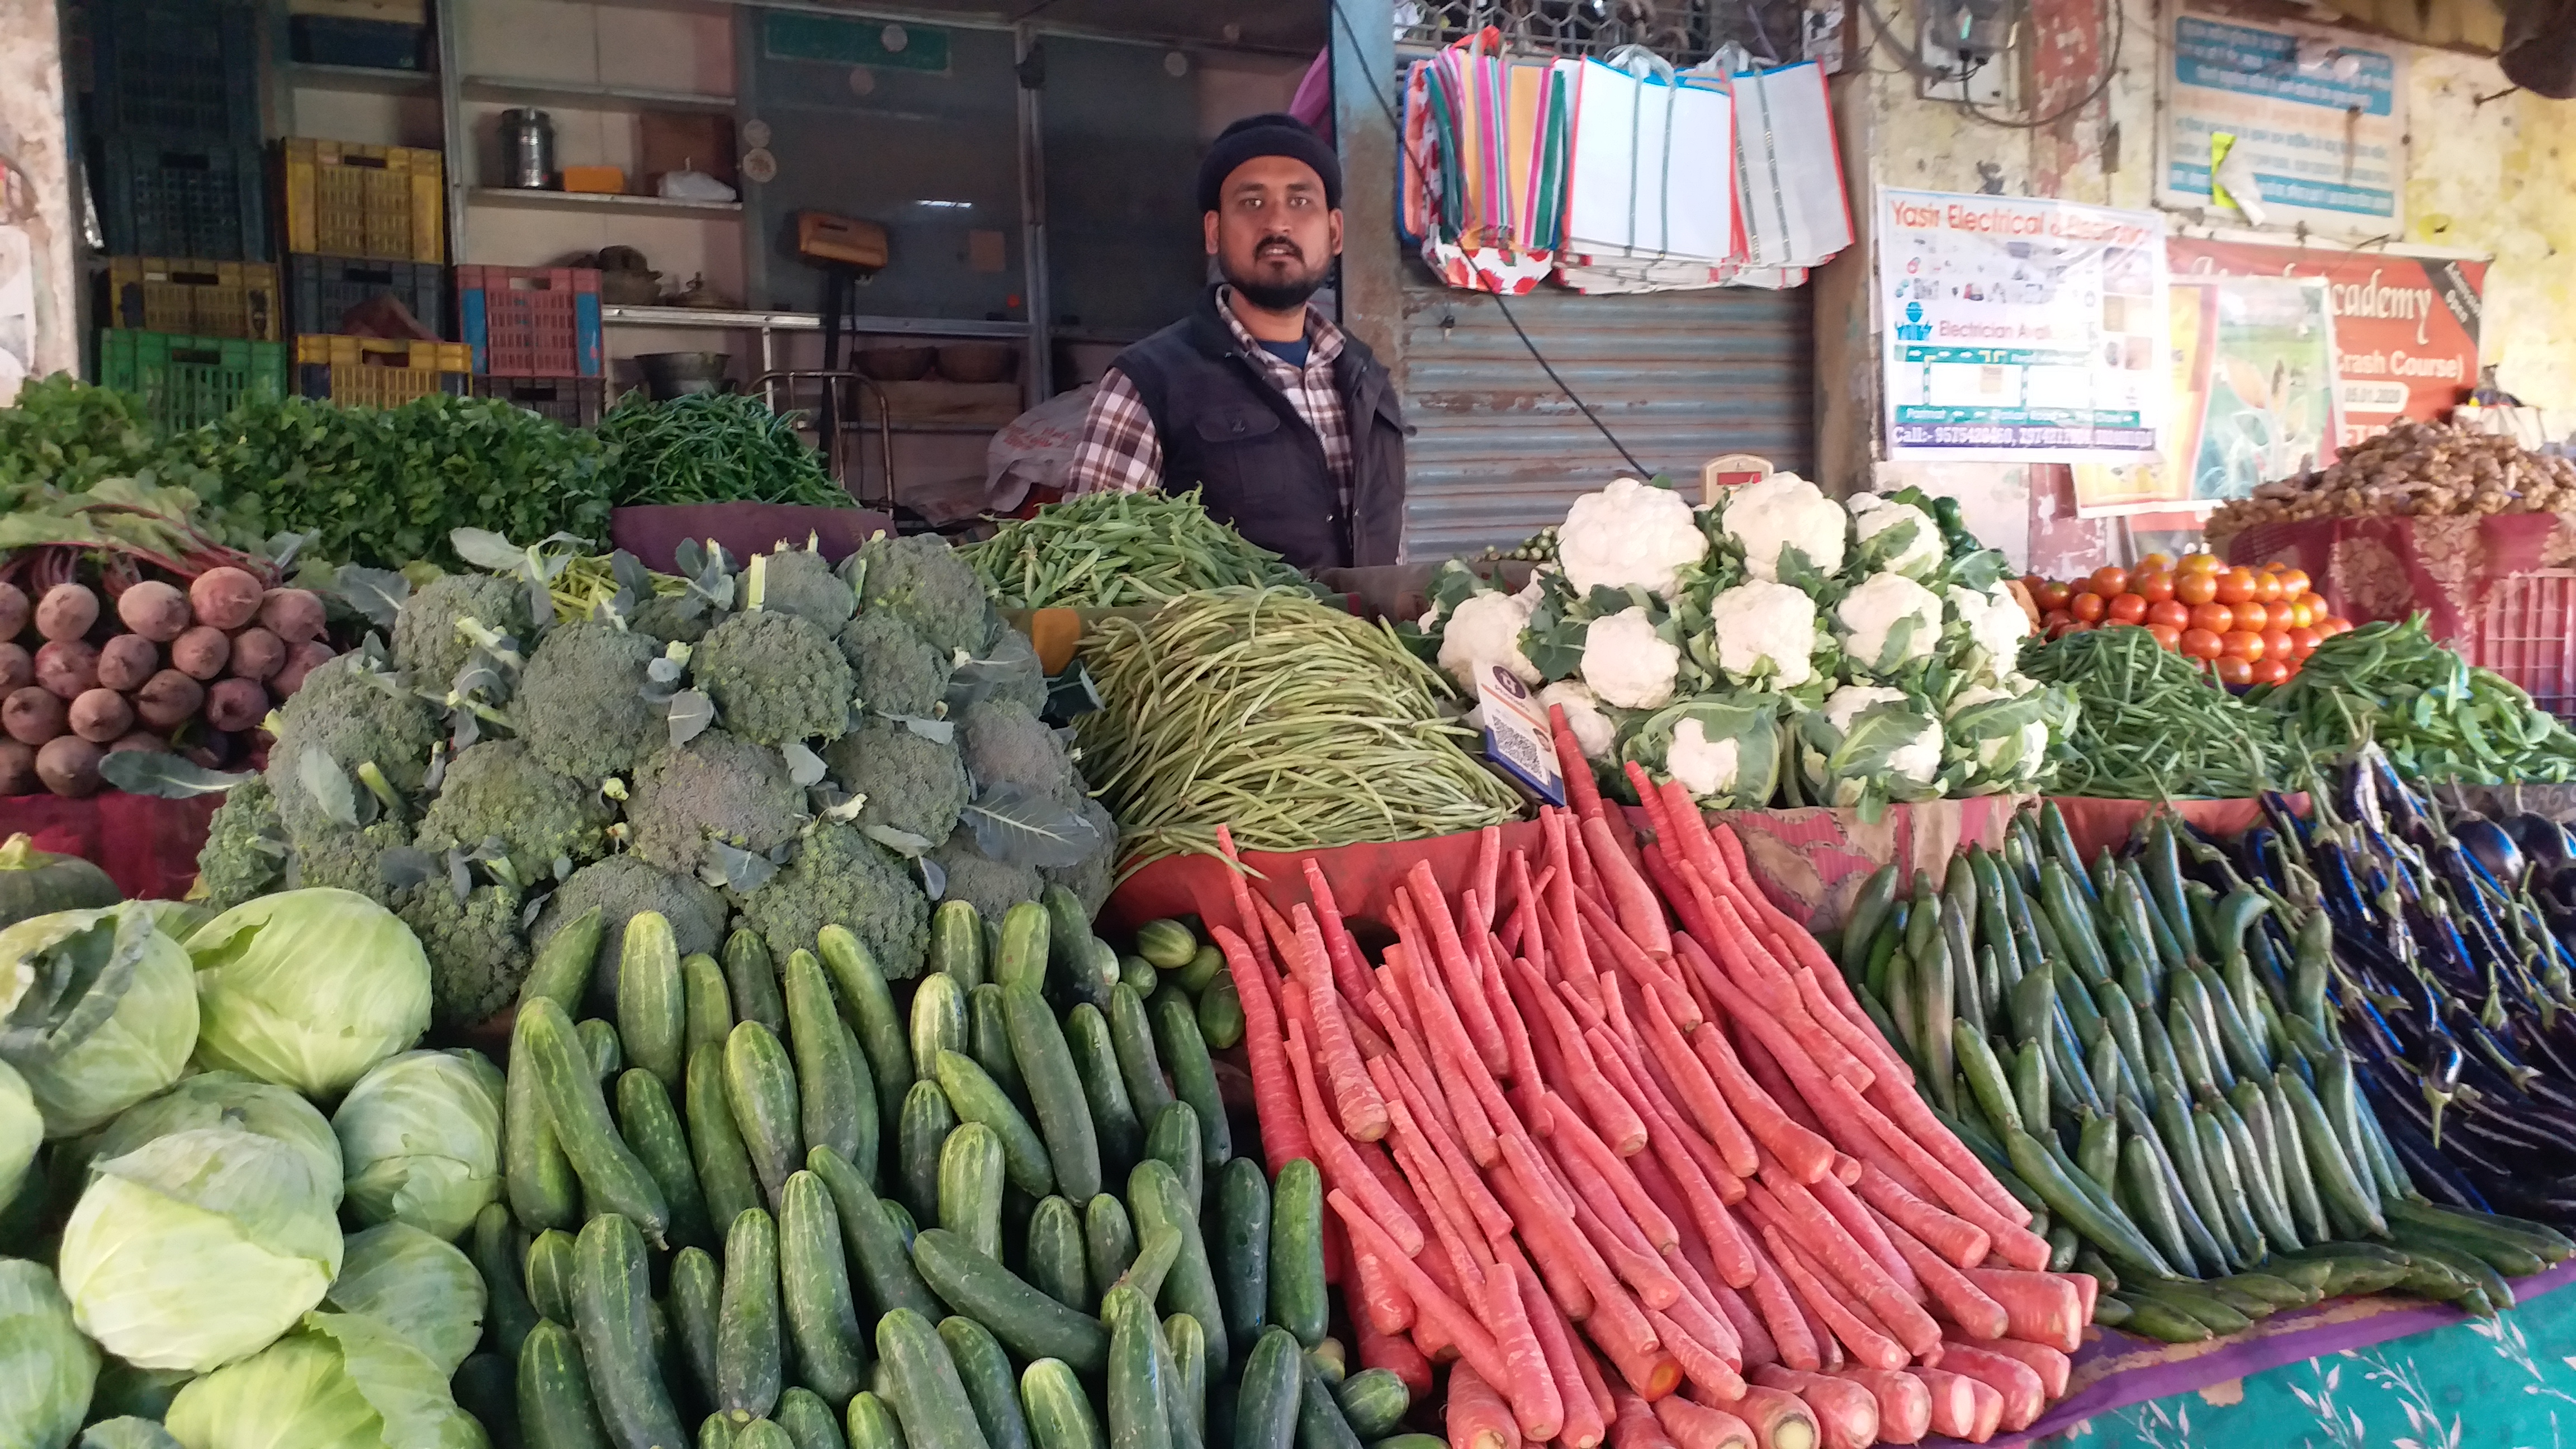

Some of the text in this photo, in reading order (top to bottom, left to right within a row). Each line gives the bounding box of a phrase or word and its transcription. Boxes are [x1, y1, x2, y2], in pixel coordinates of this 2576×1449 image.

[1891, 200, 1940, 227] Yasir
[1948, 204, 2045, 235] Electrical
[2330, 268, 2432, 345] cademy
[1939, 320, 2012, 338] Electrician
[2390, 350, 2464, 383] Course)
